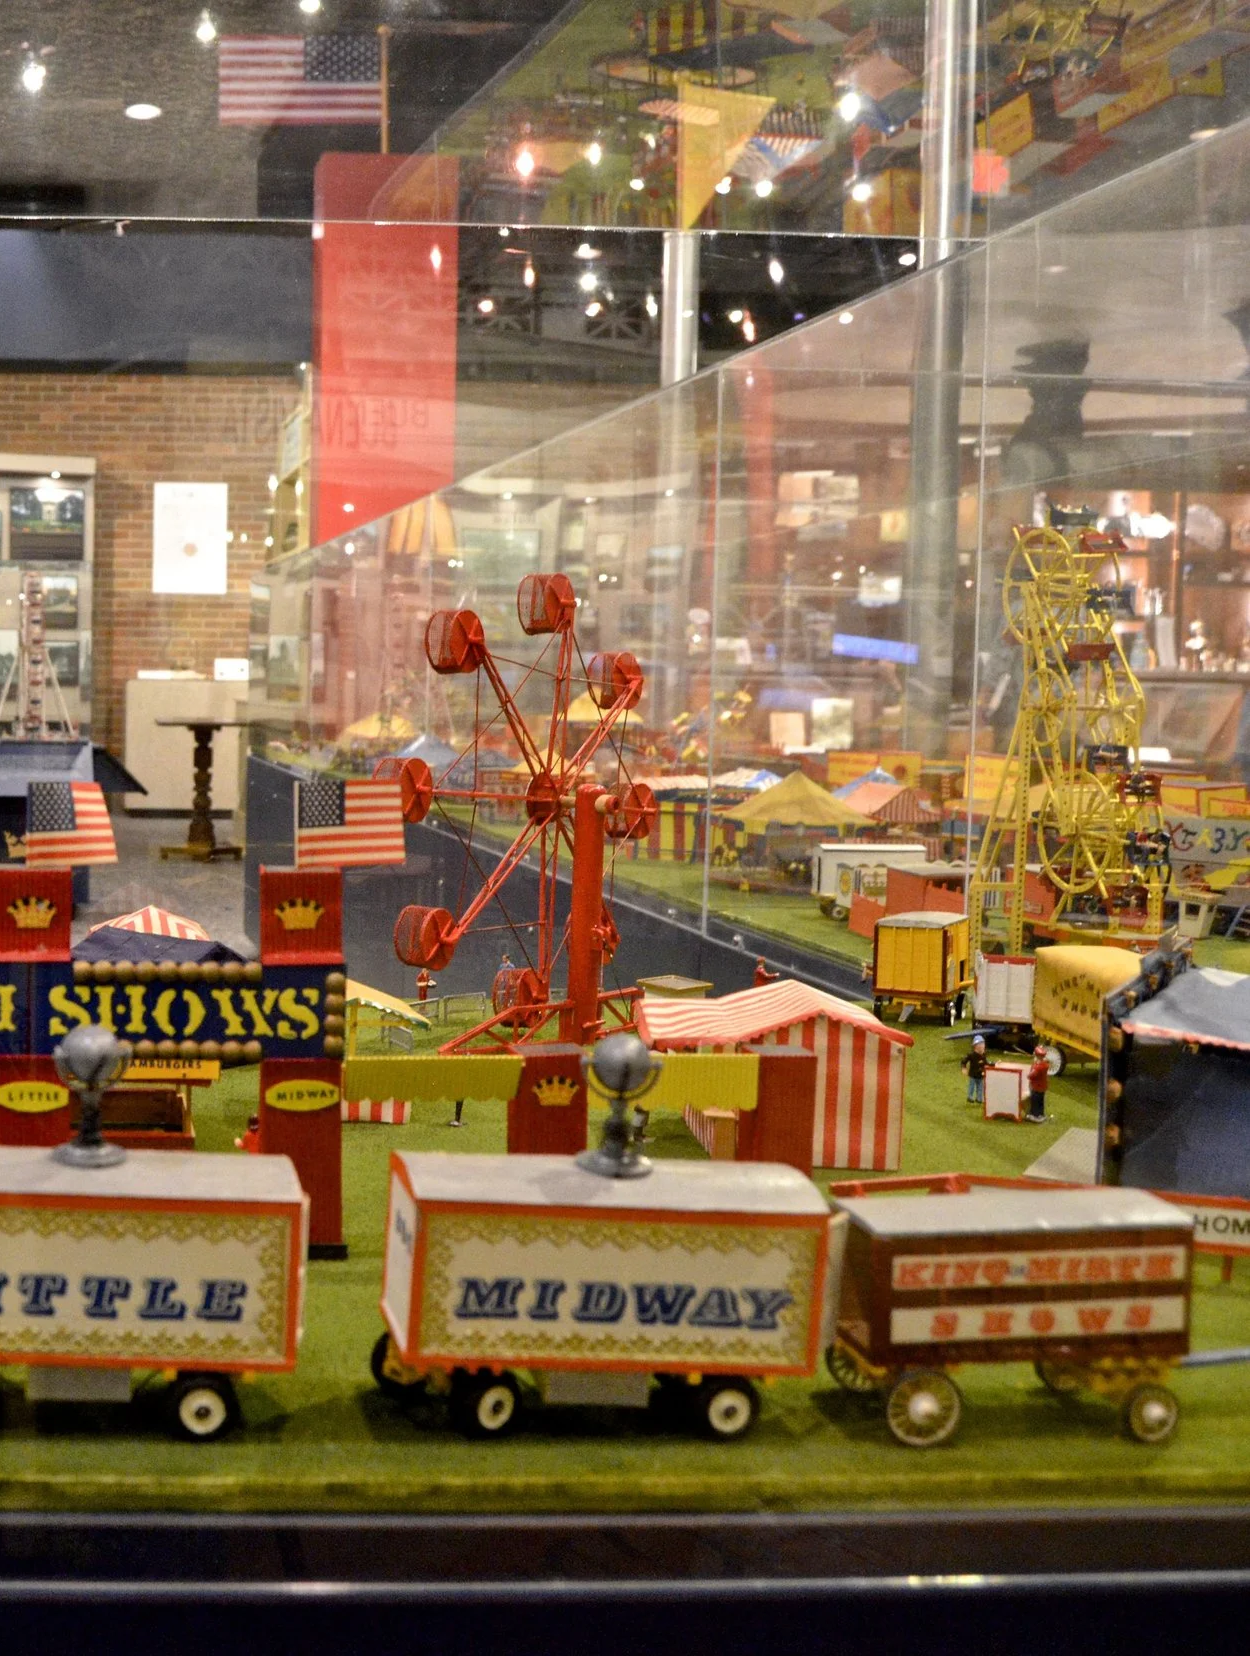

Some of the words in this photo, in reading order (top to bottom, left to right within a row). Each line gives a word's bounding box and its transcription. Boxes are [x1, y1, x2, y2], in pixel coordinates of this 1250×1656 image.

[49, 984, 322, 1040] SHOWS
[1061, 997, 1099, 1020] SHOW
[129, 1059, 202, 1070] AMBURGERS
[7, 1090, 61, 1103] LITTLE
[275, 1088, 337, 1103] MIDWAY
[895, 1259, 1010, 1287] KING
[1026, 1252, 1175, 1281] MIRTH
[455, 1277, 793, 1329] MIDWAY
[930, 1302, 1153, 1339] SHOWS
